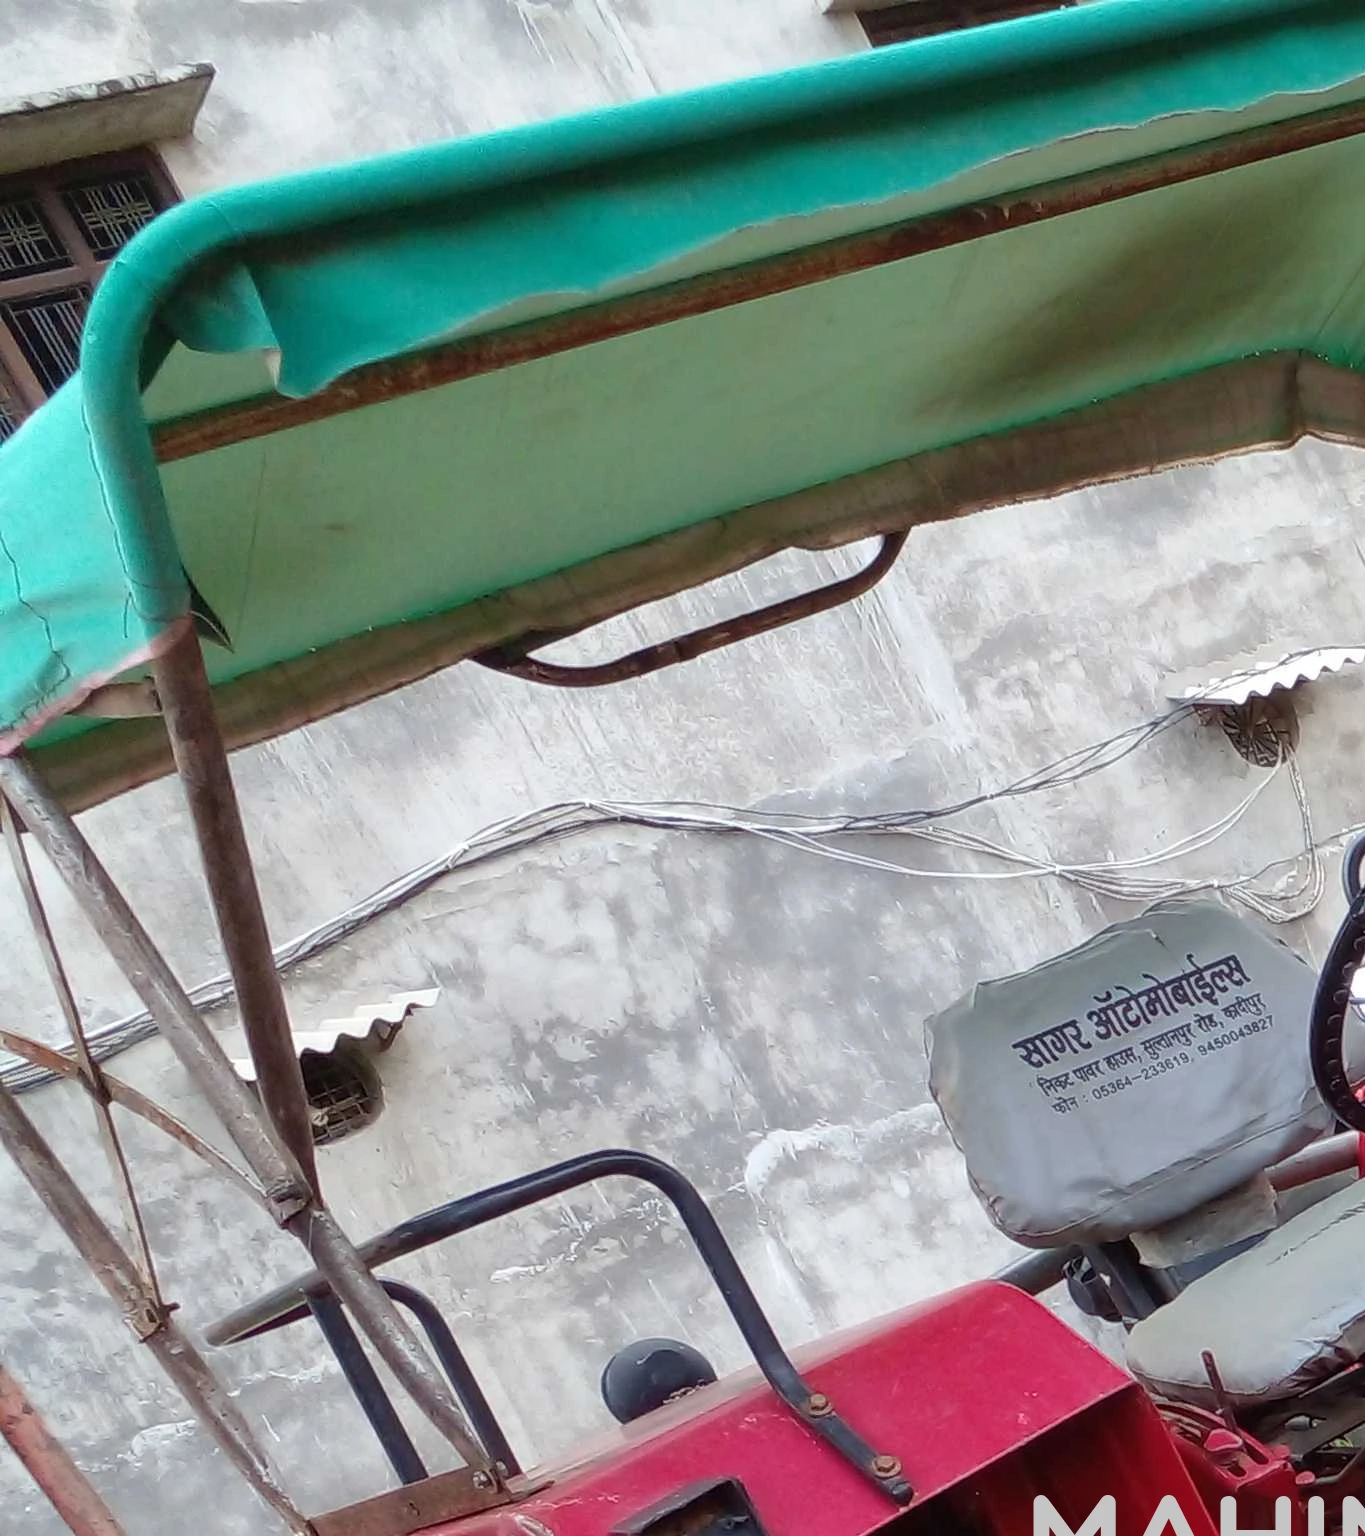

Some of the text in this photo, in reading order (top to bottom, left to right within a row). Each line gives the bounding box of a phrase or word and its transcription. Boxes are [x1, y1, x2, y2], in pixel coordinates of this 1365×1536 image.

[1011, 1018, 1093, 1068] सागर
[1197, 1014, 1273, 1056] 9450043827
[1036, 1073, 1075, 1097] निकट
[1072, 1059, 1105, 1082] पावर
